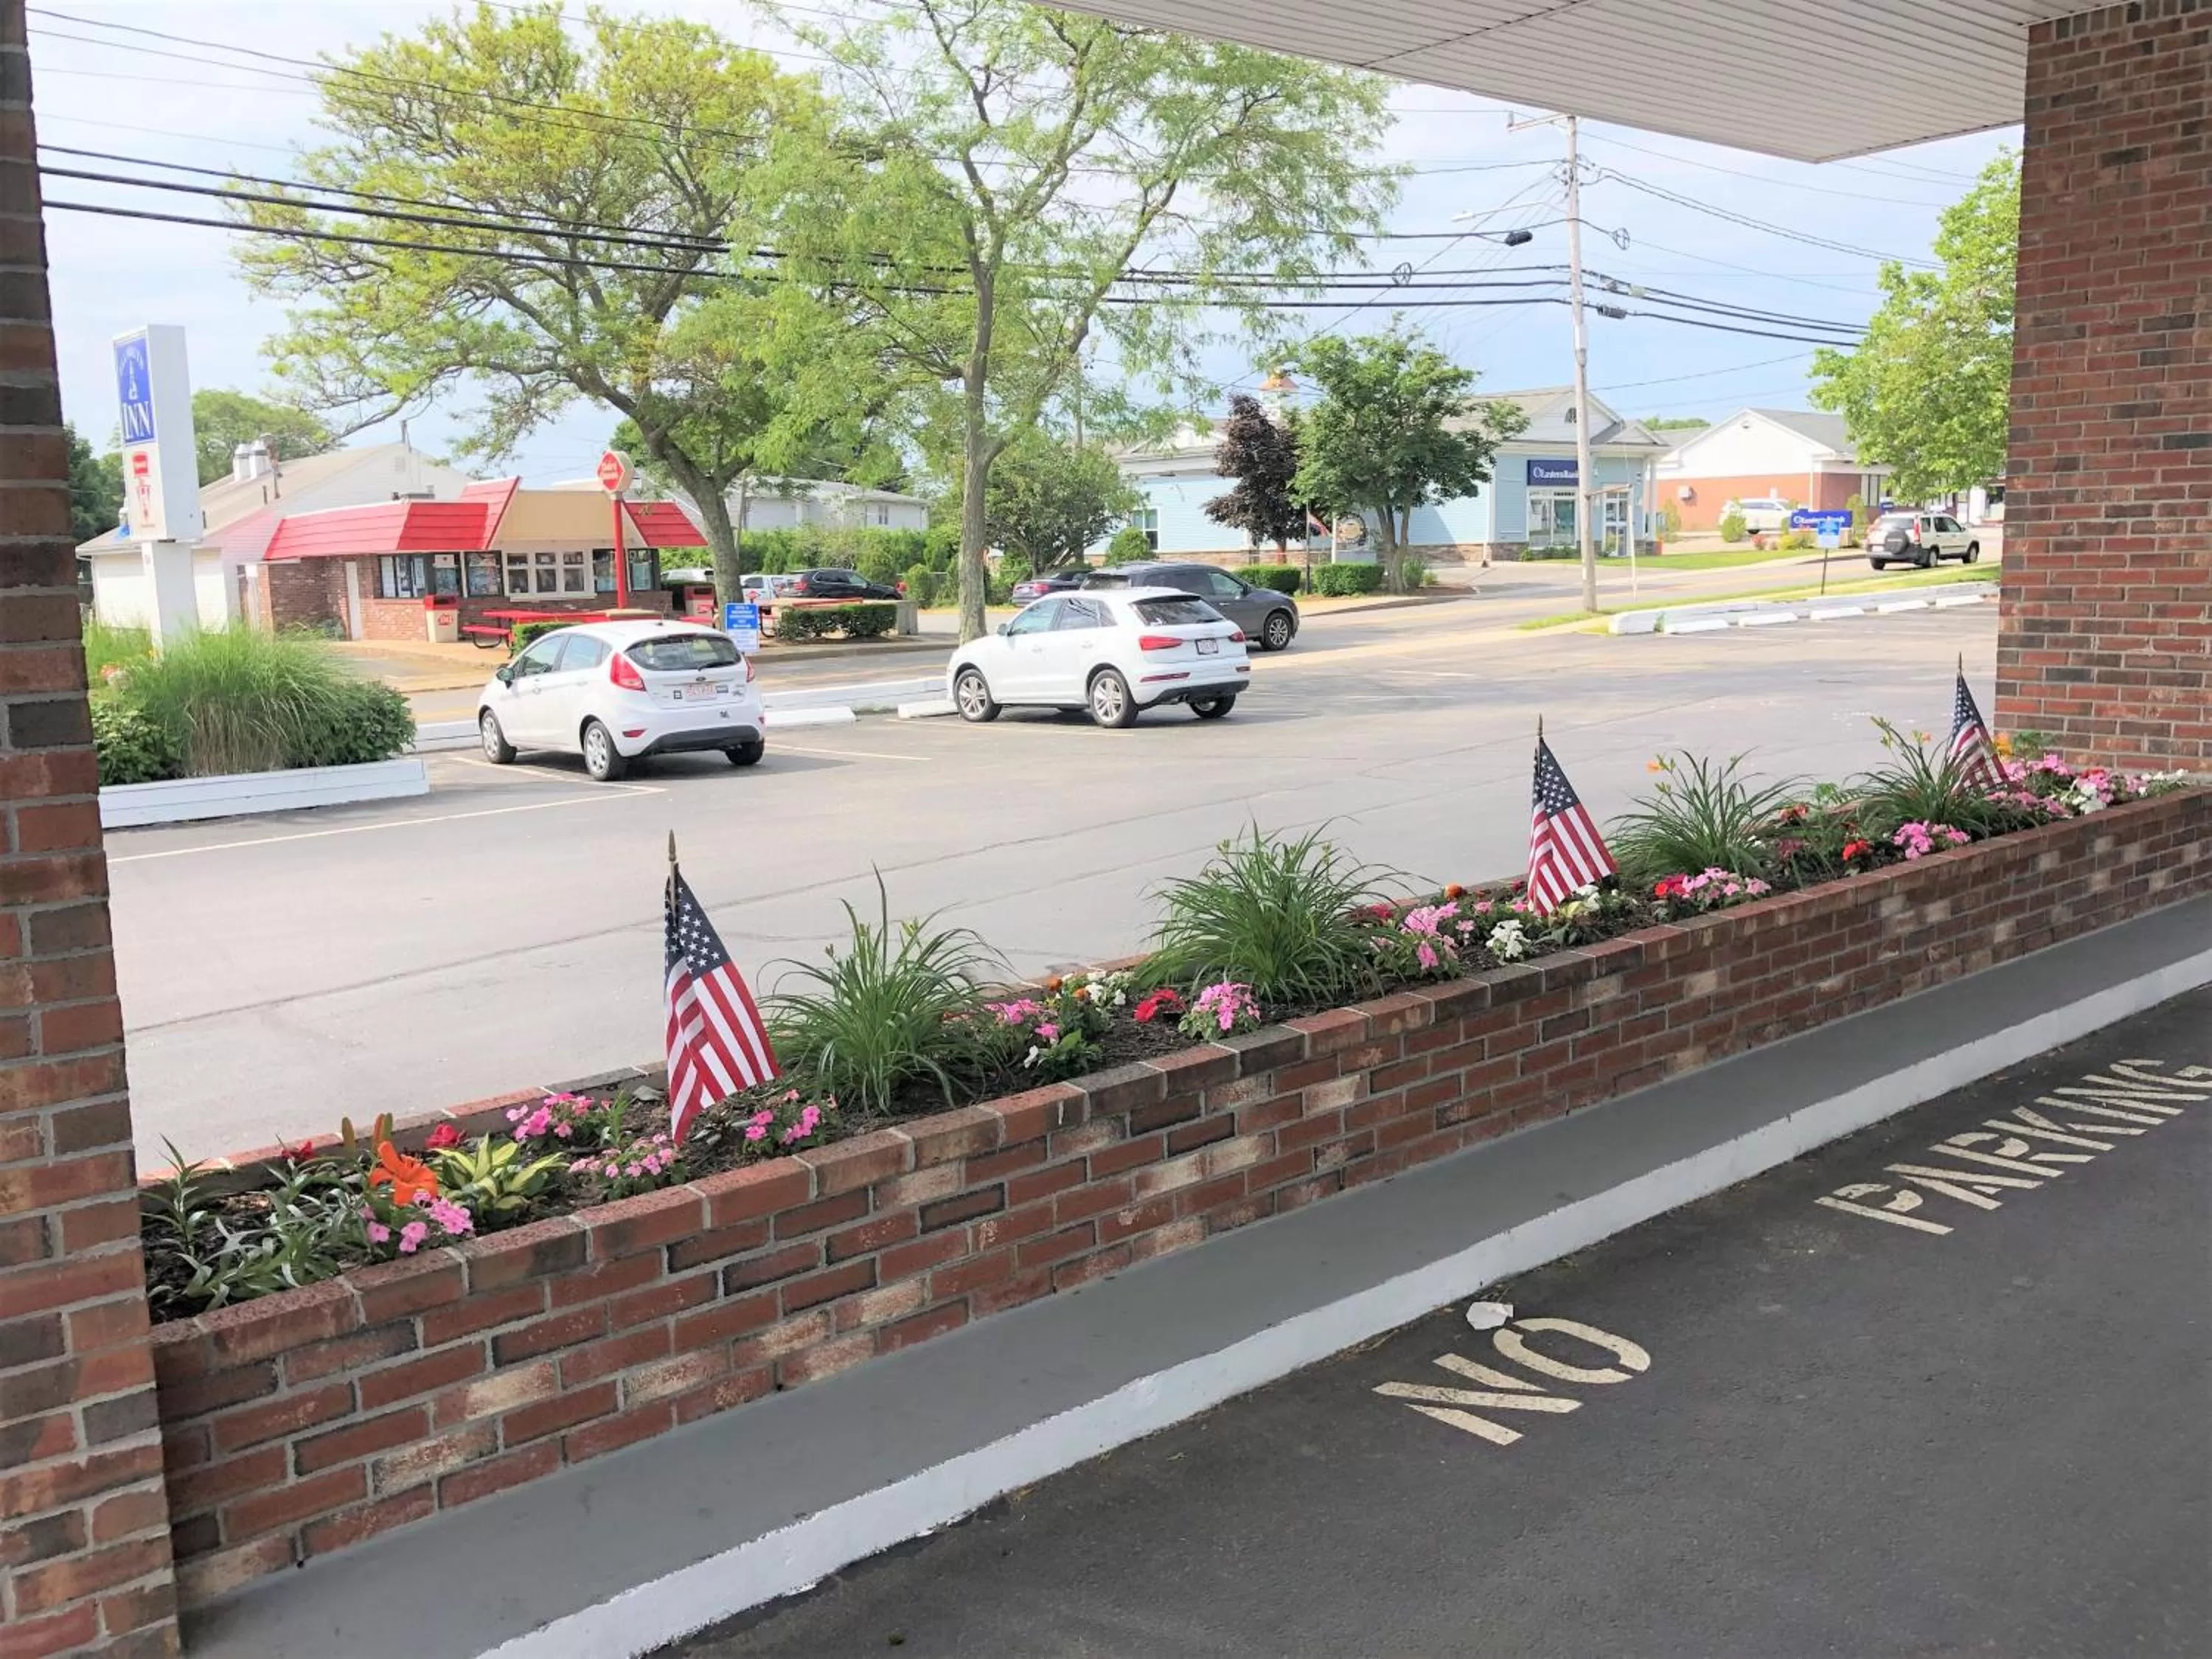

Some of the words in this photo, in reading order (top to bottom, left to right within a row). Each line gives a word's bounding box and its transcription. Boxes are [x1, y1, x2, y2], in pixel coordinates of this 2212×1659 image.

[122, 400, 151, 439] INN
[1371, 1318, 1651, 1445] NO
[1814, 1059, 2212, 1235] PARKING
